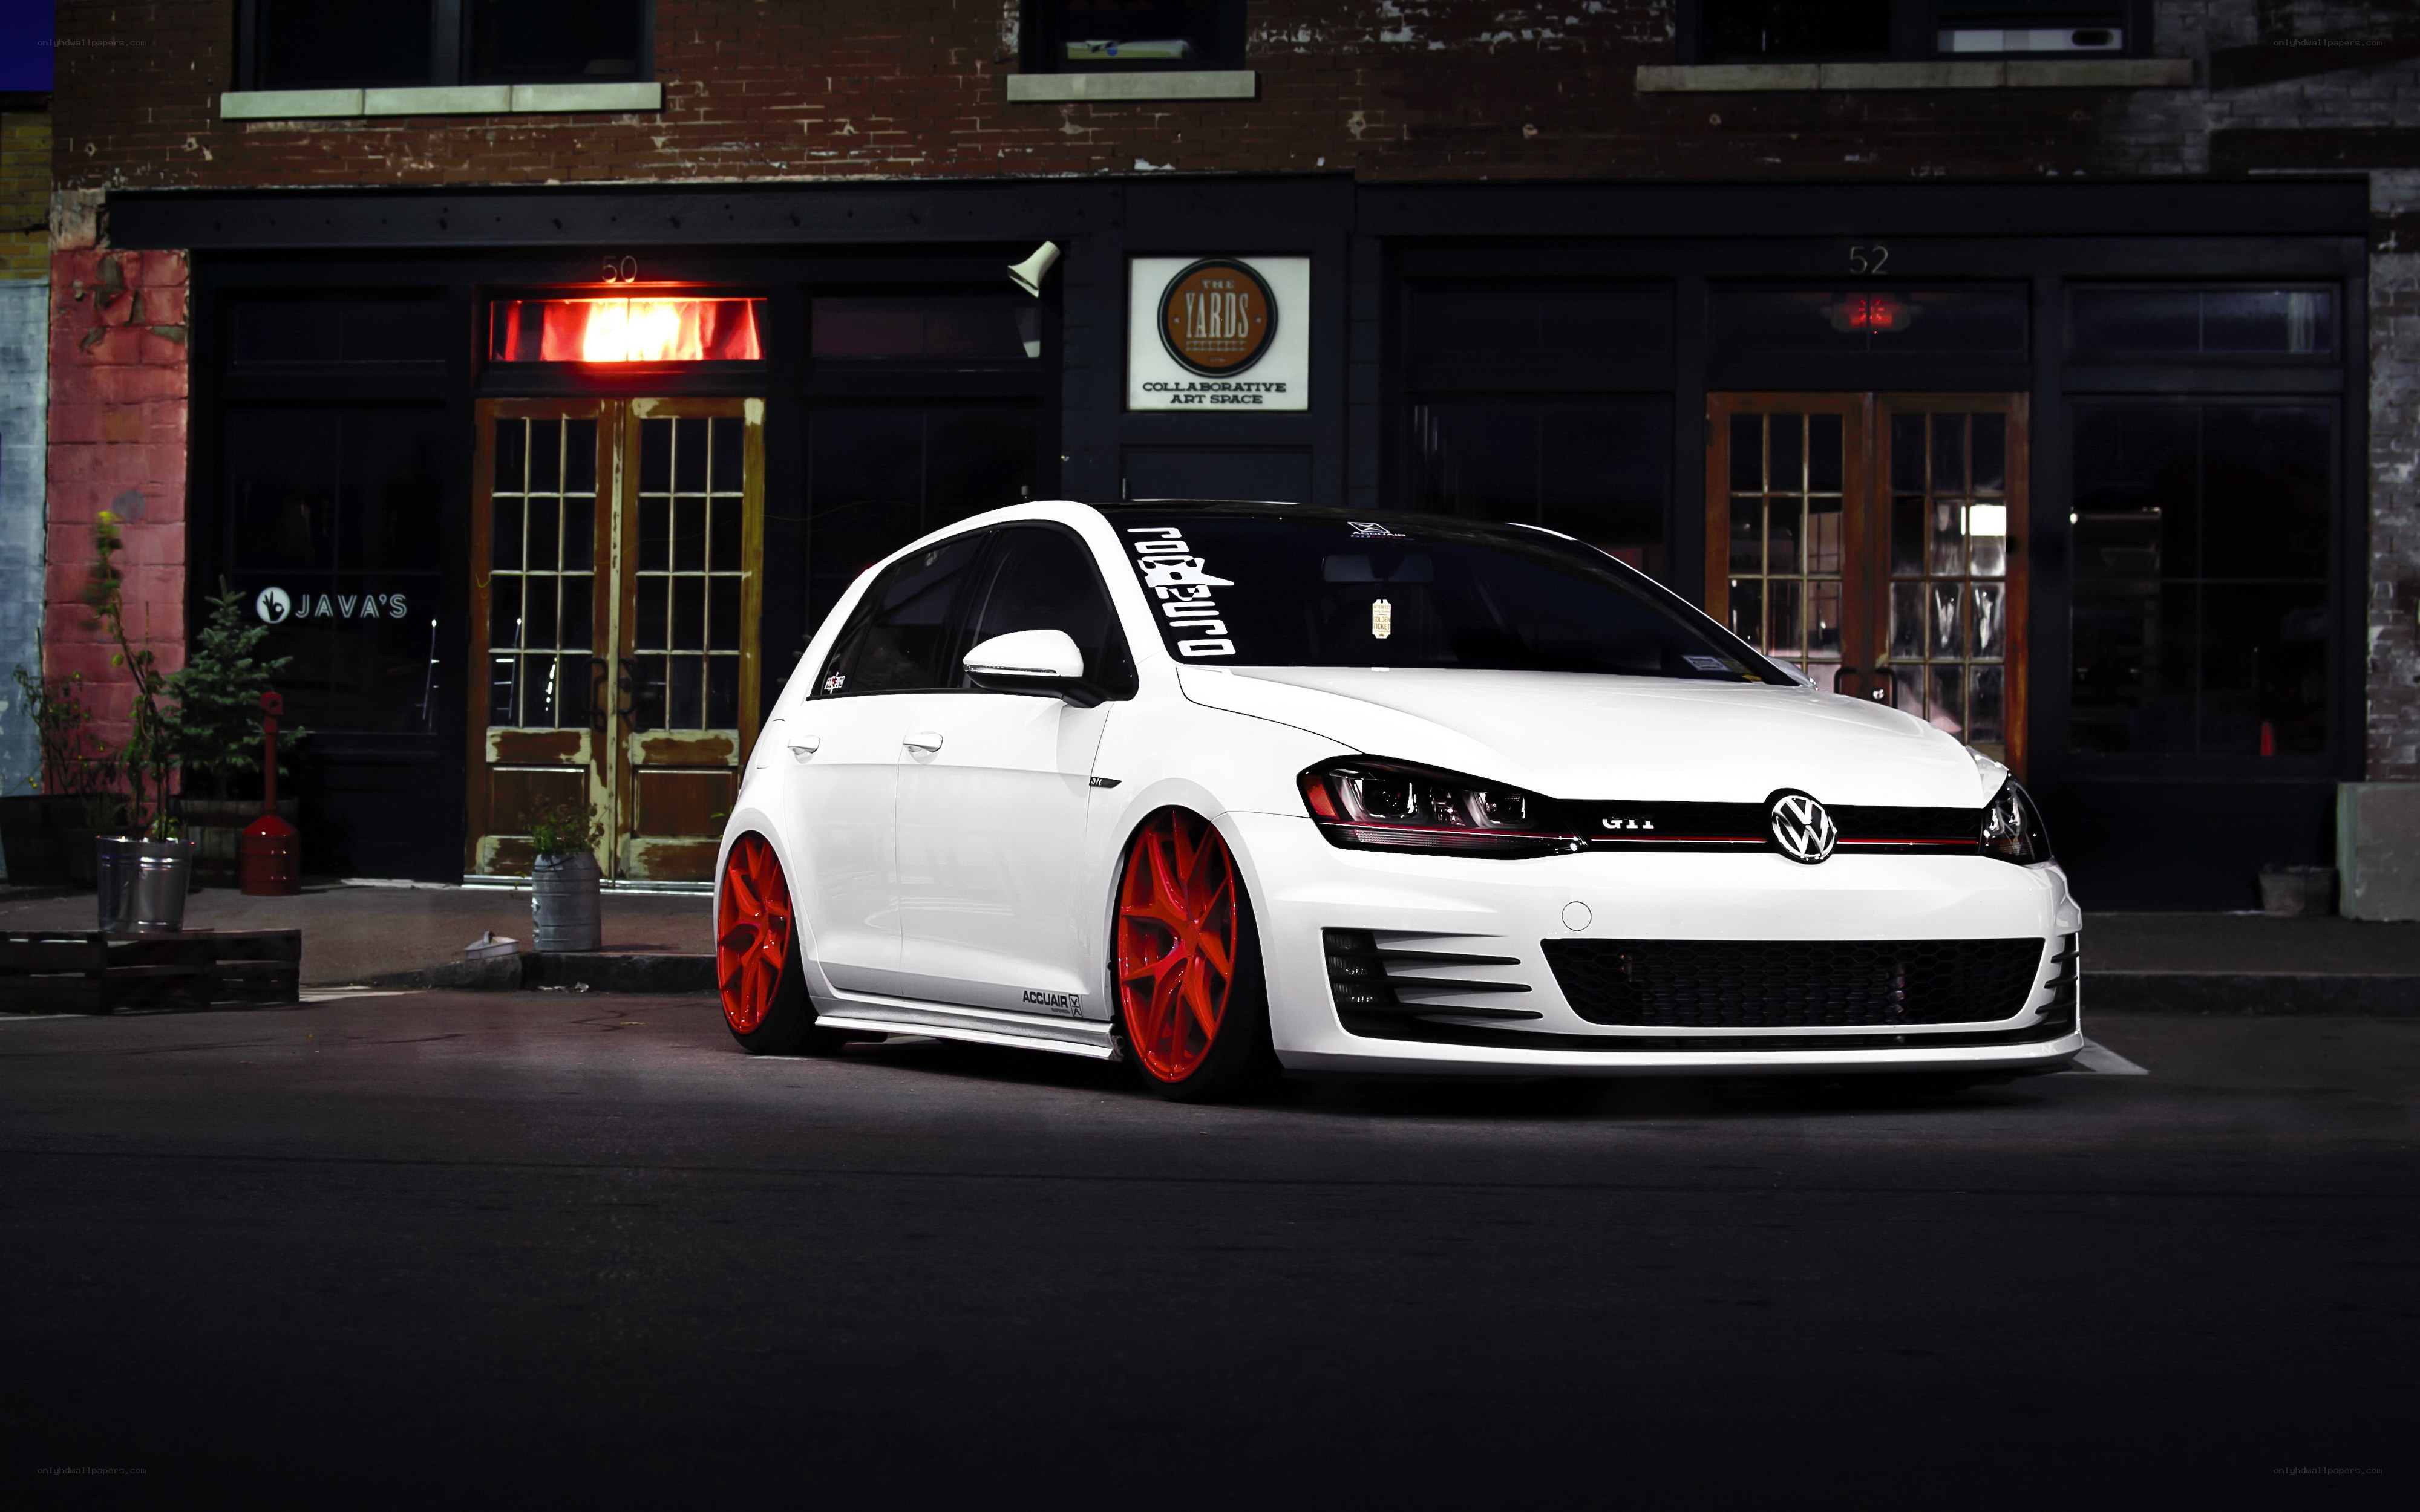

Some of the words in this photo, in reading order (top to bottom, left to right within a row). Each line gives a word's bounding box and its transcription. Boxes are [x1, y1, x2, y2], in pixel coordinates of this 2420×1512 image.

[601, 255, 638, 283] 50
[1849, 246, 1889, 274] 52
[1201, 279, 1235, 289] THE
[1185, 292, 1250, 339] YARDS
[1142, 382, 1287, 393] COLLABORATIVE
[1170, 394, 1206, 404] ART
[1210, 395, 1263, 404] SPACE
[295, 593, 407, 618] JAVA'S
[1022, 990, 1068, 1008] ACCUAIR
